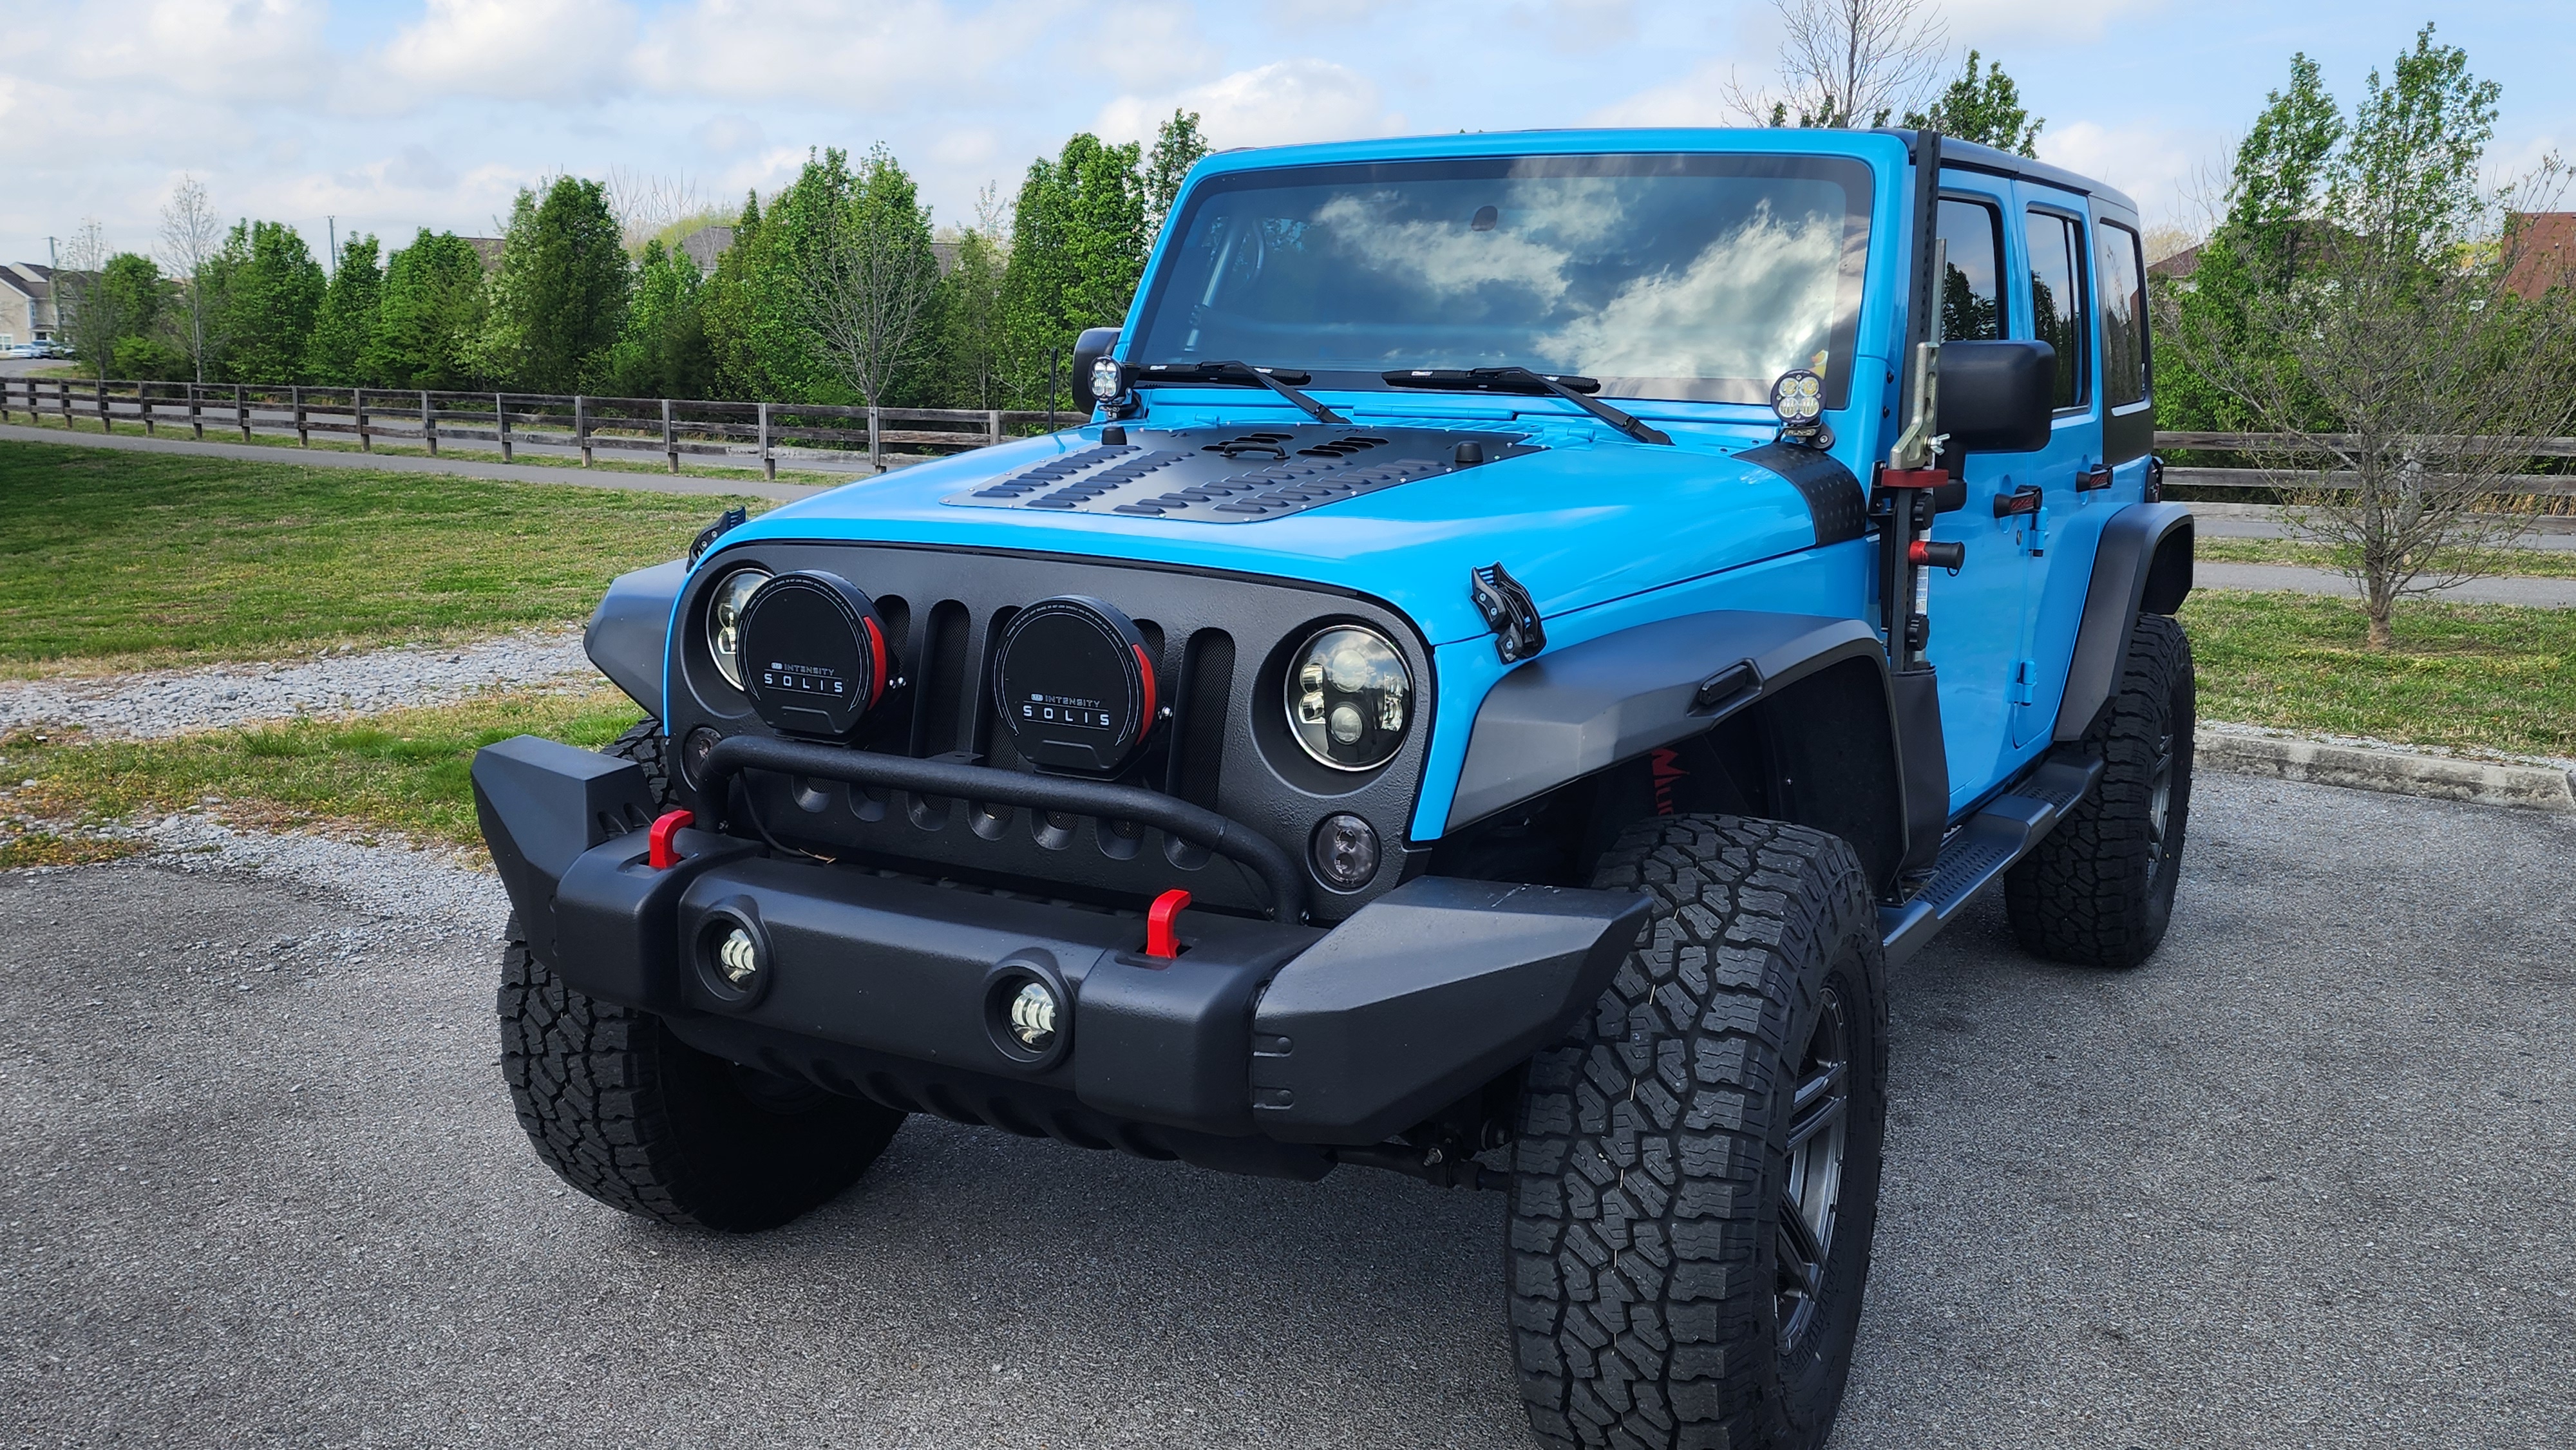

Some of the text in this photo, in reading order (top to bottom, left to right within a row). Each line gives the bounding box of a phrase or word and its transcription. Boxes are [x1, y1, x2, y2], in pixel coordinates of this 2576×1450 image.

[784, 663, 835, 676] INTENSITY
[764, 673, 843, 693] SOLIS
[1045, 695, 1101, 708] INTENSITY
[1023, 705, 1109, 726] SOLIS
